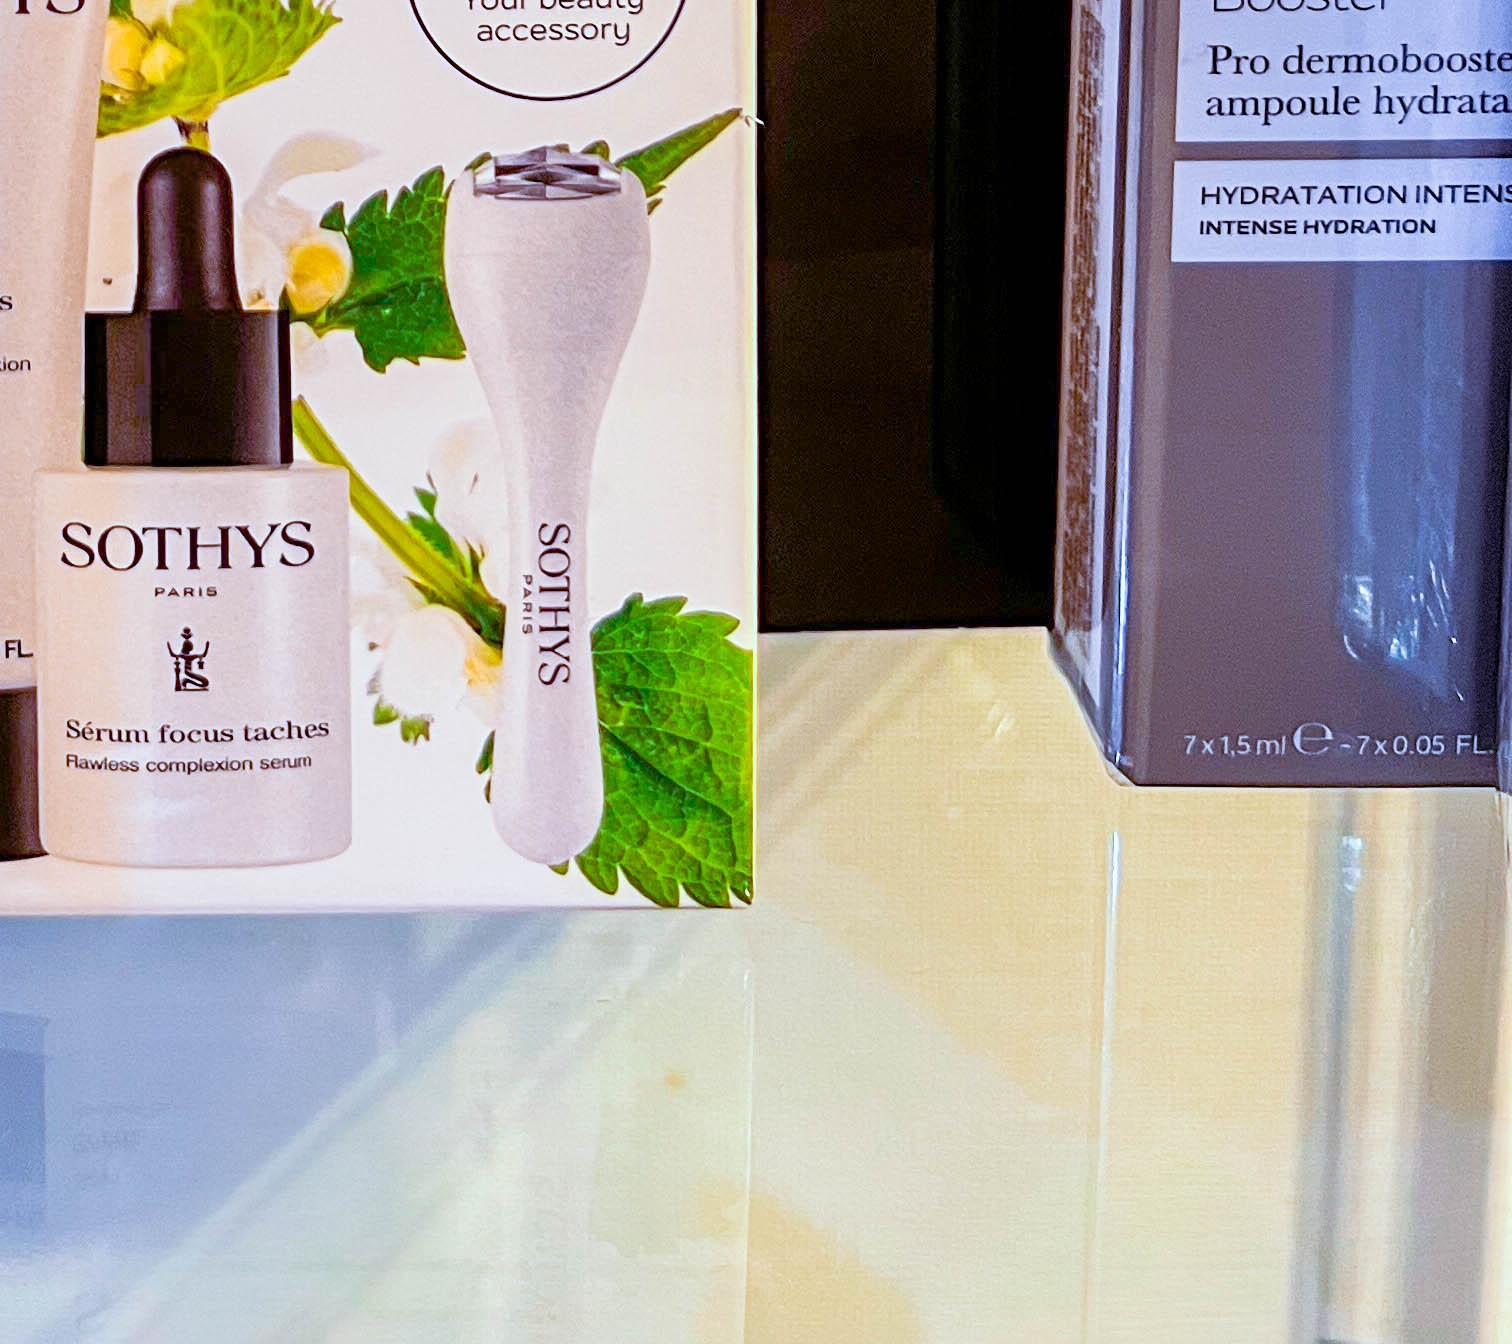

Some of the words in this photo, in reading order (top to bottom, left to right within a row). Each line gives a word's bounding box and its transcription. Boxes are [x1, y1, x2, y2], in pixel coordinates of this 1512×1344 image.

[477, 19, 630, 46] accessory
[1207, 45, 1270, 75] Pro
[1206, 87, 1360, 125] ampoule
[1201, 185, 1407, 205] HYDRATATION
[1200, 220, 1297, 236] INTENSE
[1303, 219, 1436, 235] HYDRATION
[61, 521, 314, 571] SOTHYS
[155, 587, 217, 597] PARIS
[522, 575, 533, 635] PARIS
[538, 523, 571, 686] SOTHYS
[66, 719, 148, 743] Sérum
[158, 725, 234, 744] focus
[244, 721, 329, 742] taches
[1184, 735, 1196, 755] 7
[1256, 736, 1286, 755] ml
[1358, 736, 1369, 754] 7
[1393, 735, 1445, 754] 0.05
[66, 754, 139, 772] Flawless
[146, 756, 253, 775] complexion
[259, 753, 311, 770] serum
